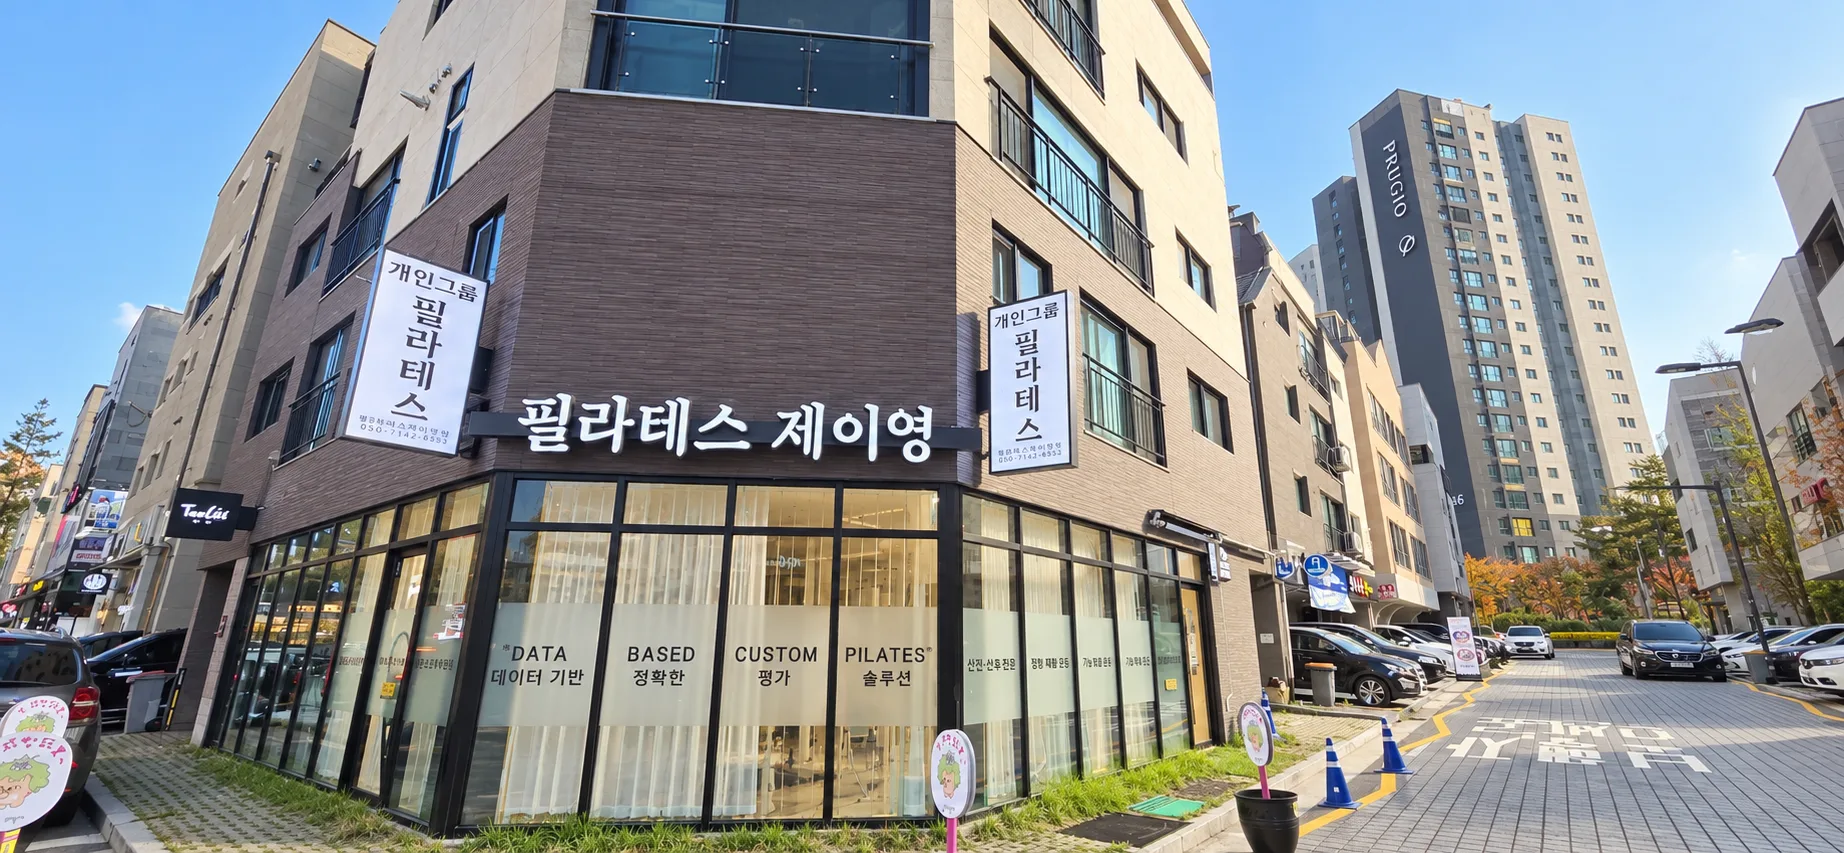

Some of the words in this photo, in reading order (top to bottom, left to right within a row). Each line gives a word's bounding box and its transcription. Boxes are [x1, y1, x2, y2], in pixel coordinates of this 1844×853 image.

[1383, 139, 1407, 217] PRUGIO
[388, 261, 479, 303] 개인그룹
[994, 302, 1059, 329] 개인그룹
[390, 295, 447, 421] 필라테스
[1015, 329, 1042, 442] 필라테스
[518, 393, 751, 458] 필라테스
[771, 401, 933, 463] 제이영
[511, 646, 567, 662] DATA
[627, 646, 695, 662] BASED
[735, 646, 817, 663] CUSTOM
[491, 669, 542, 686] 데이터
[550, 669, 584, 686] 기반
[633, 669, 685, 687] 정확한
[758, 669, 791, 687] 평가
[863, 669, 911, 687] 솔루션
